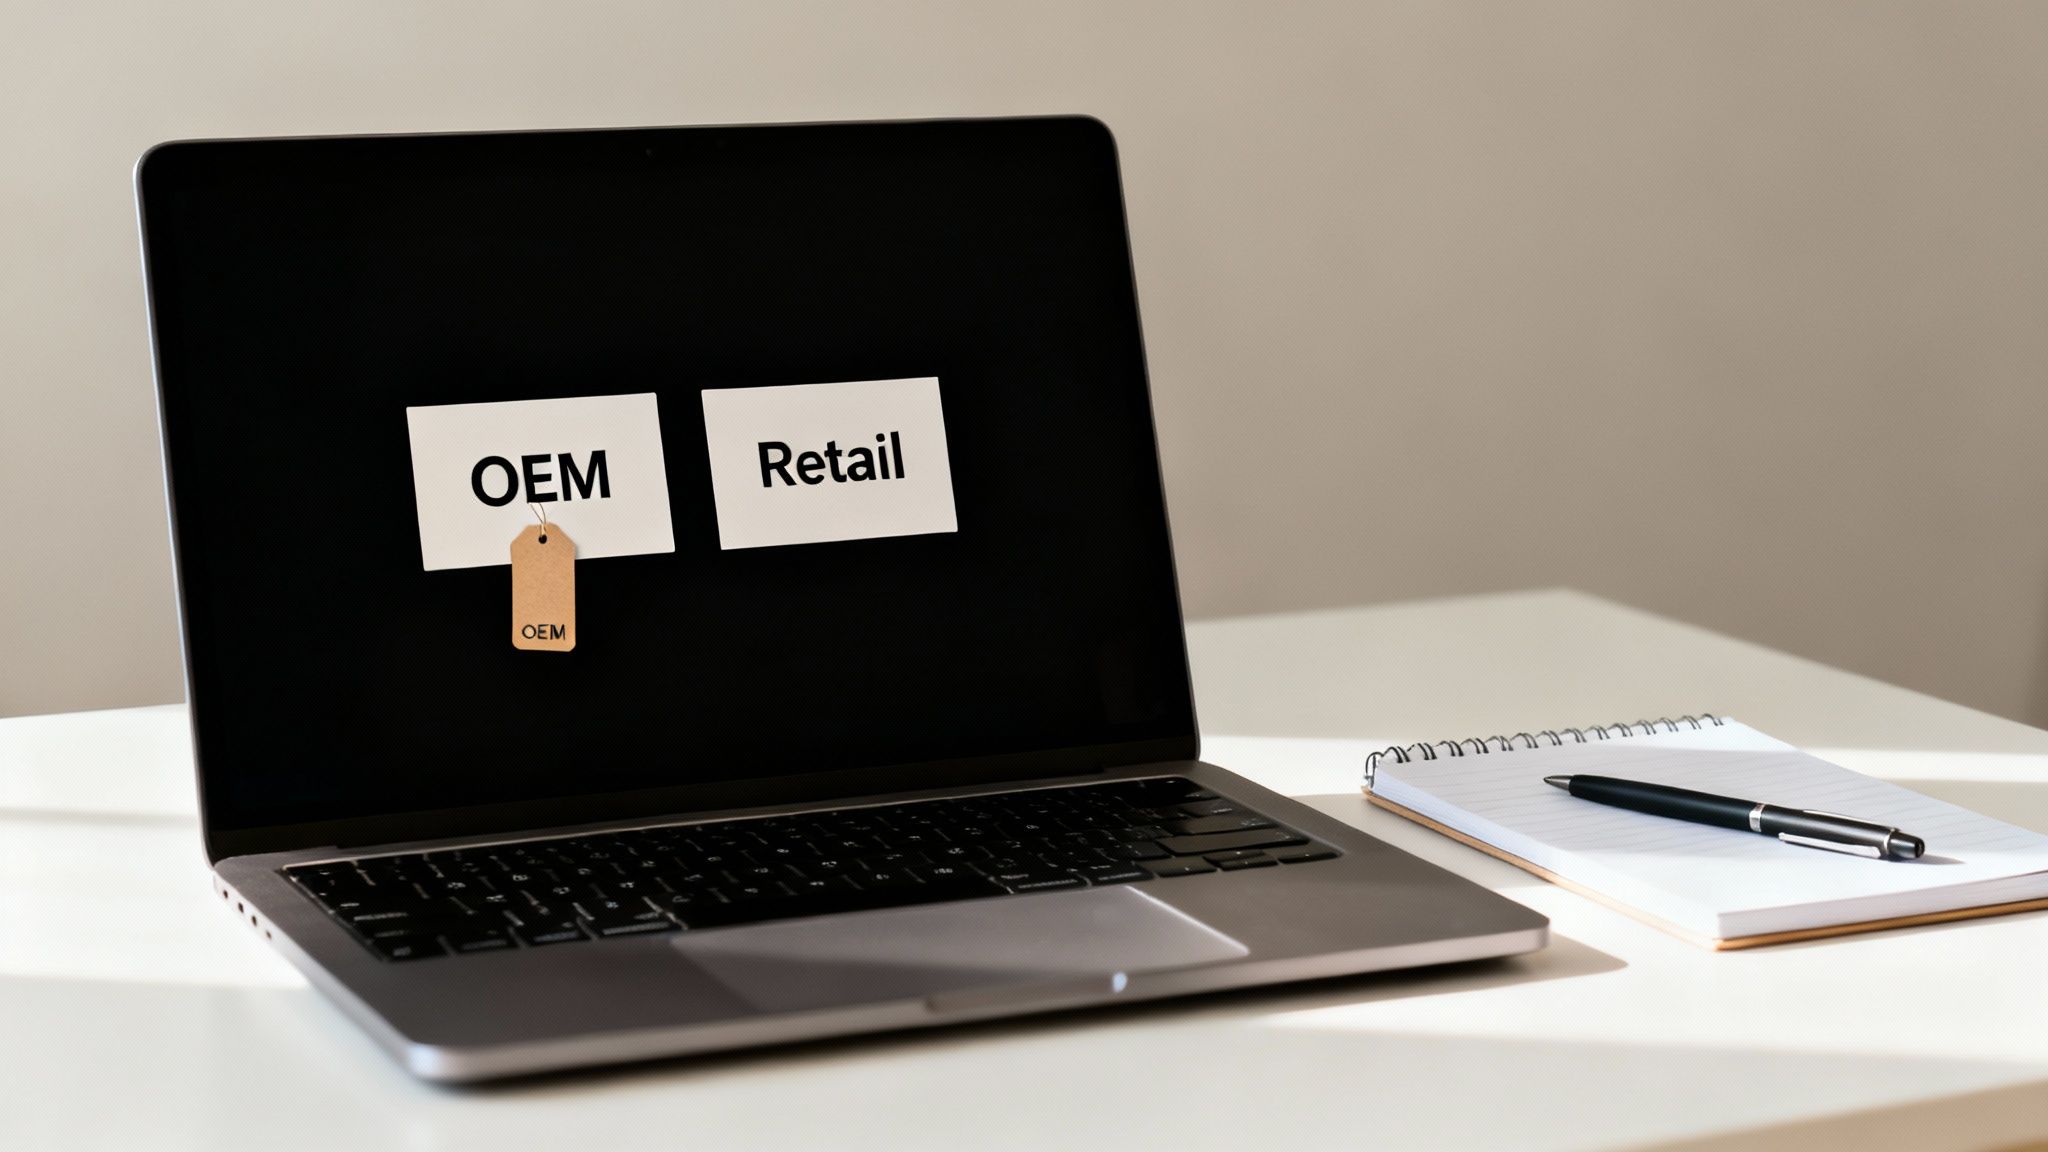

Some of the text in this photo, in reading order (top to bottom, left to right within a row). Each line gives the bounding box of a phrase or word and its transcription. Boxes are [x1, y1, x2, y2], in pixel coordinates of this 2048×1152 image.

[471, 450, 611, 508] OEM
[757, 431, 905, 488] Retail
[521, 623, 567, 641] OEM
